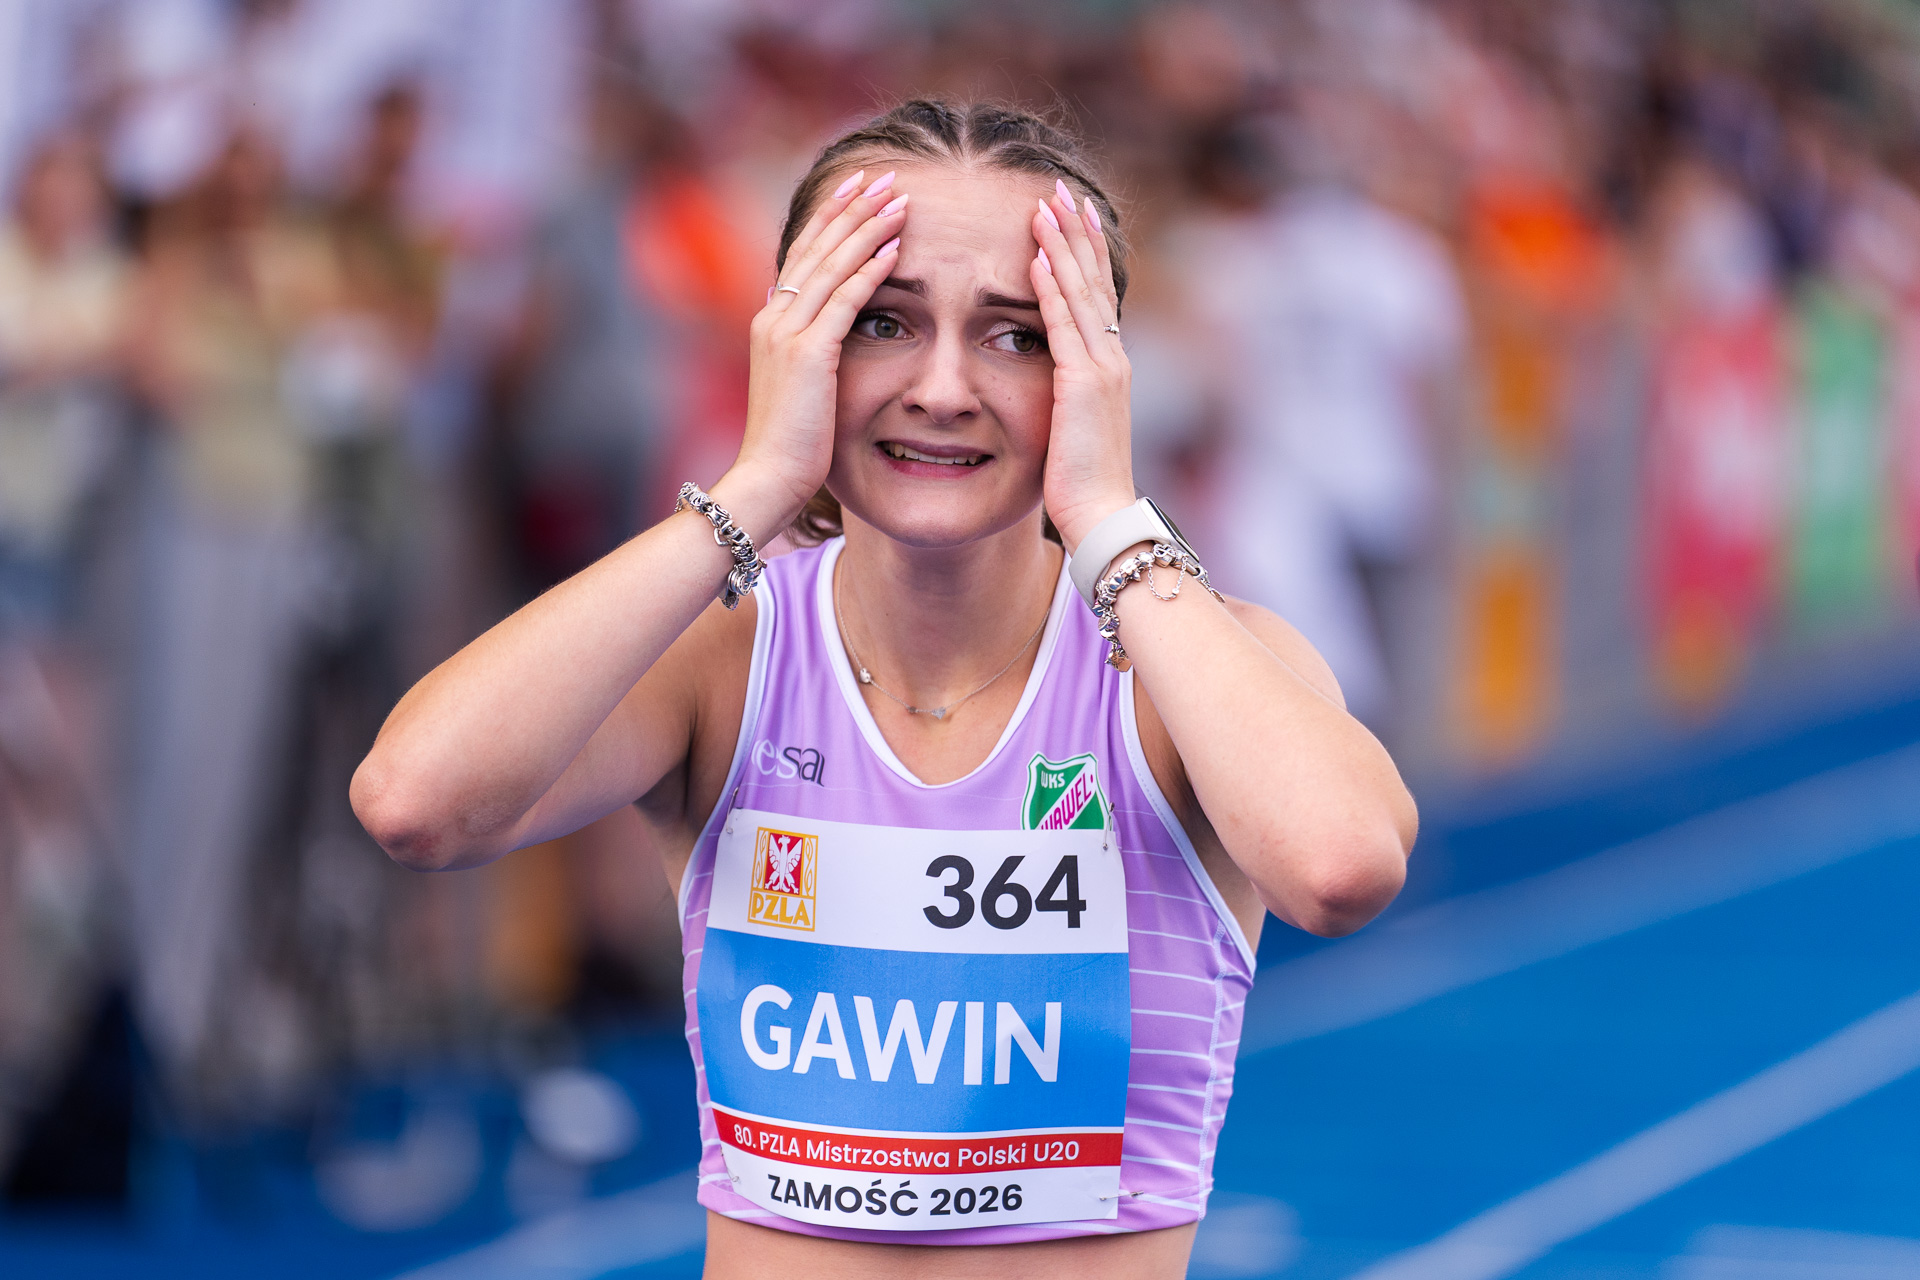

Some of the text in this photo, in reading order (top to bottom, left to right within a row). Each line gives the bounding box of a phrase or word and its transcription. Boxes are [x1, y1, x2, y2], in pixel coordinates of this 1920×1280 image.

[751, 892, 811, 926] PZLA
[923, 855, 1087, 930] 364
[741, 984, 1061, 1085] GAWIN
[733, 1123, 1079, 1167] 80. PZLA Mistrzostwa Polski U20
[768, 1174, 1023, 1216] ZAMOŚĆ 2026
